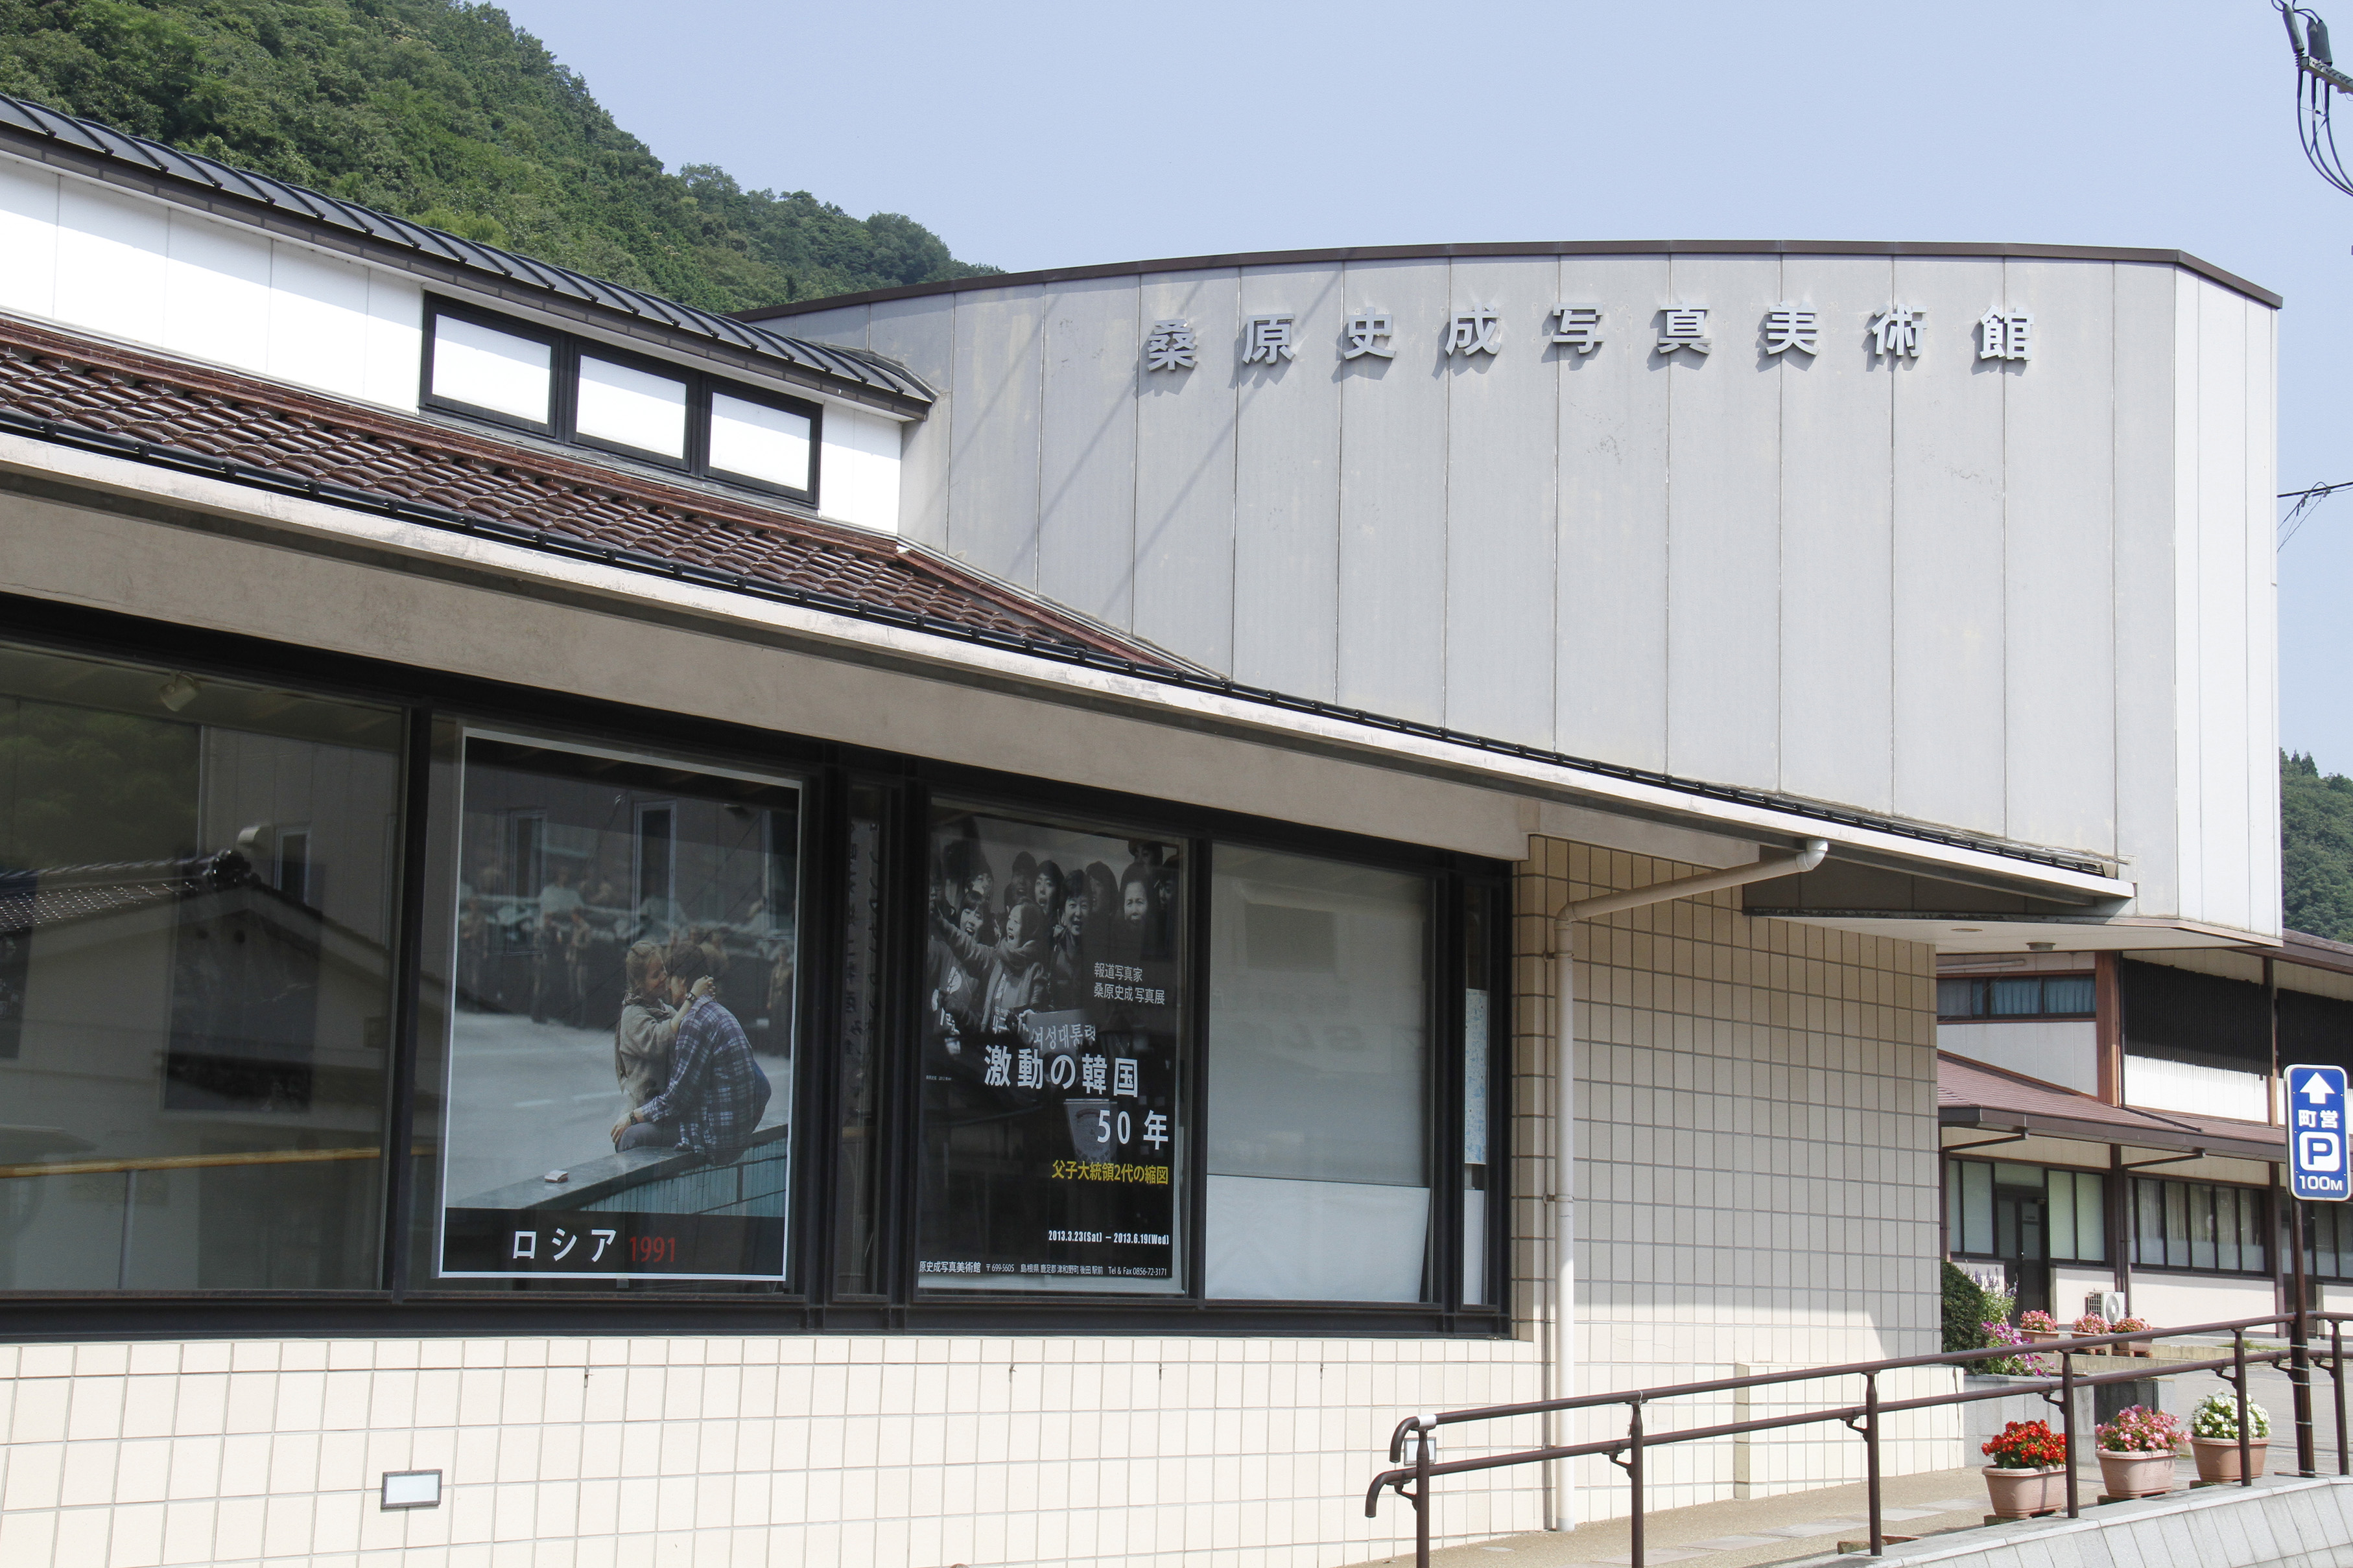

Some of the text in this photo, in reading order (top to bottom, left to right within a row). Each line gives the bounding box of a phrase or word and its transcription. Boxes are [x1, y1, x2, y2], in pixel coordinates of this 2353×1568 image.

[1147, 301, 2035, 373] 桑原史成写真美術館
[1094, 962, 1143, 983] 報道写真家
[984, 1044, 1139, 1097] 激動の韓国
[2298, 1110, 2338, 1129] 町営
[2307, 1137, 2333, 1165] P
[1052, 1159, 1168, 1185] 父子大統領2代の縮図
[2299, 1175, 2343, 1190] 100M
[512, 1228, 676, 1263] ロシア 1991
[1048, 1230, 1102, 1243] 2013.3.23(Sat)
[1113, 1232, 1169, 1245] 2013.6.19(Wed)
[1123, 1267, 1131, 1275] Fax
